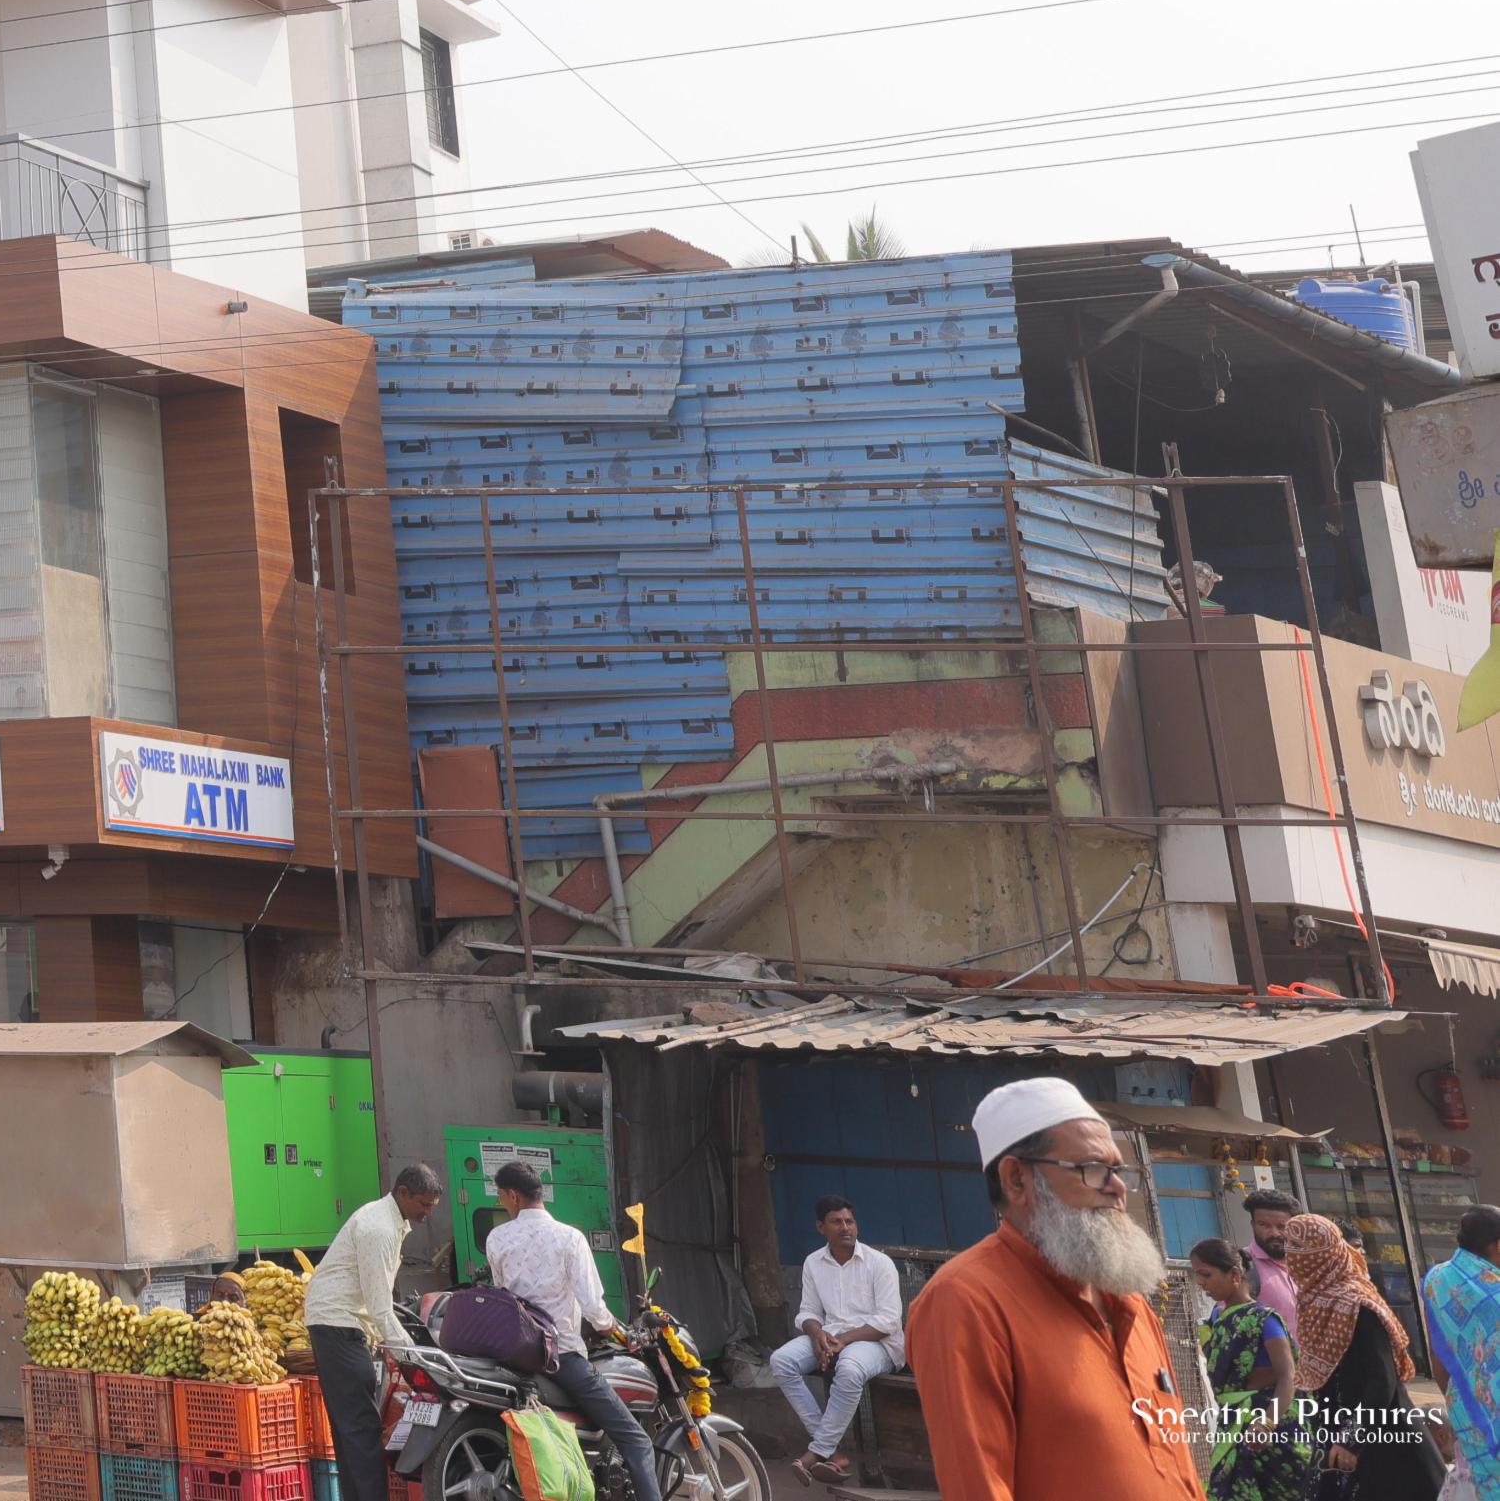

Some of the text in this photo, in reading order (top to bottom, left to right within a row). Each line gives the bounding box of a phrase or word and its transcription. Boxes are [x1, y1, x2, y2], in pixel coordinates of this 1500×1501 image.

[138, 746, 286, 789] SHREE MAHALAXMI BANK
[184, 782, 250, 833] ATM
